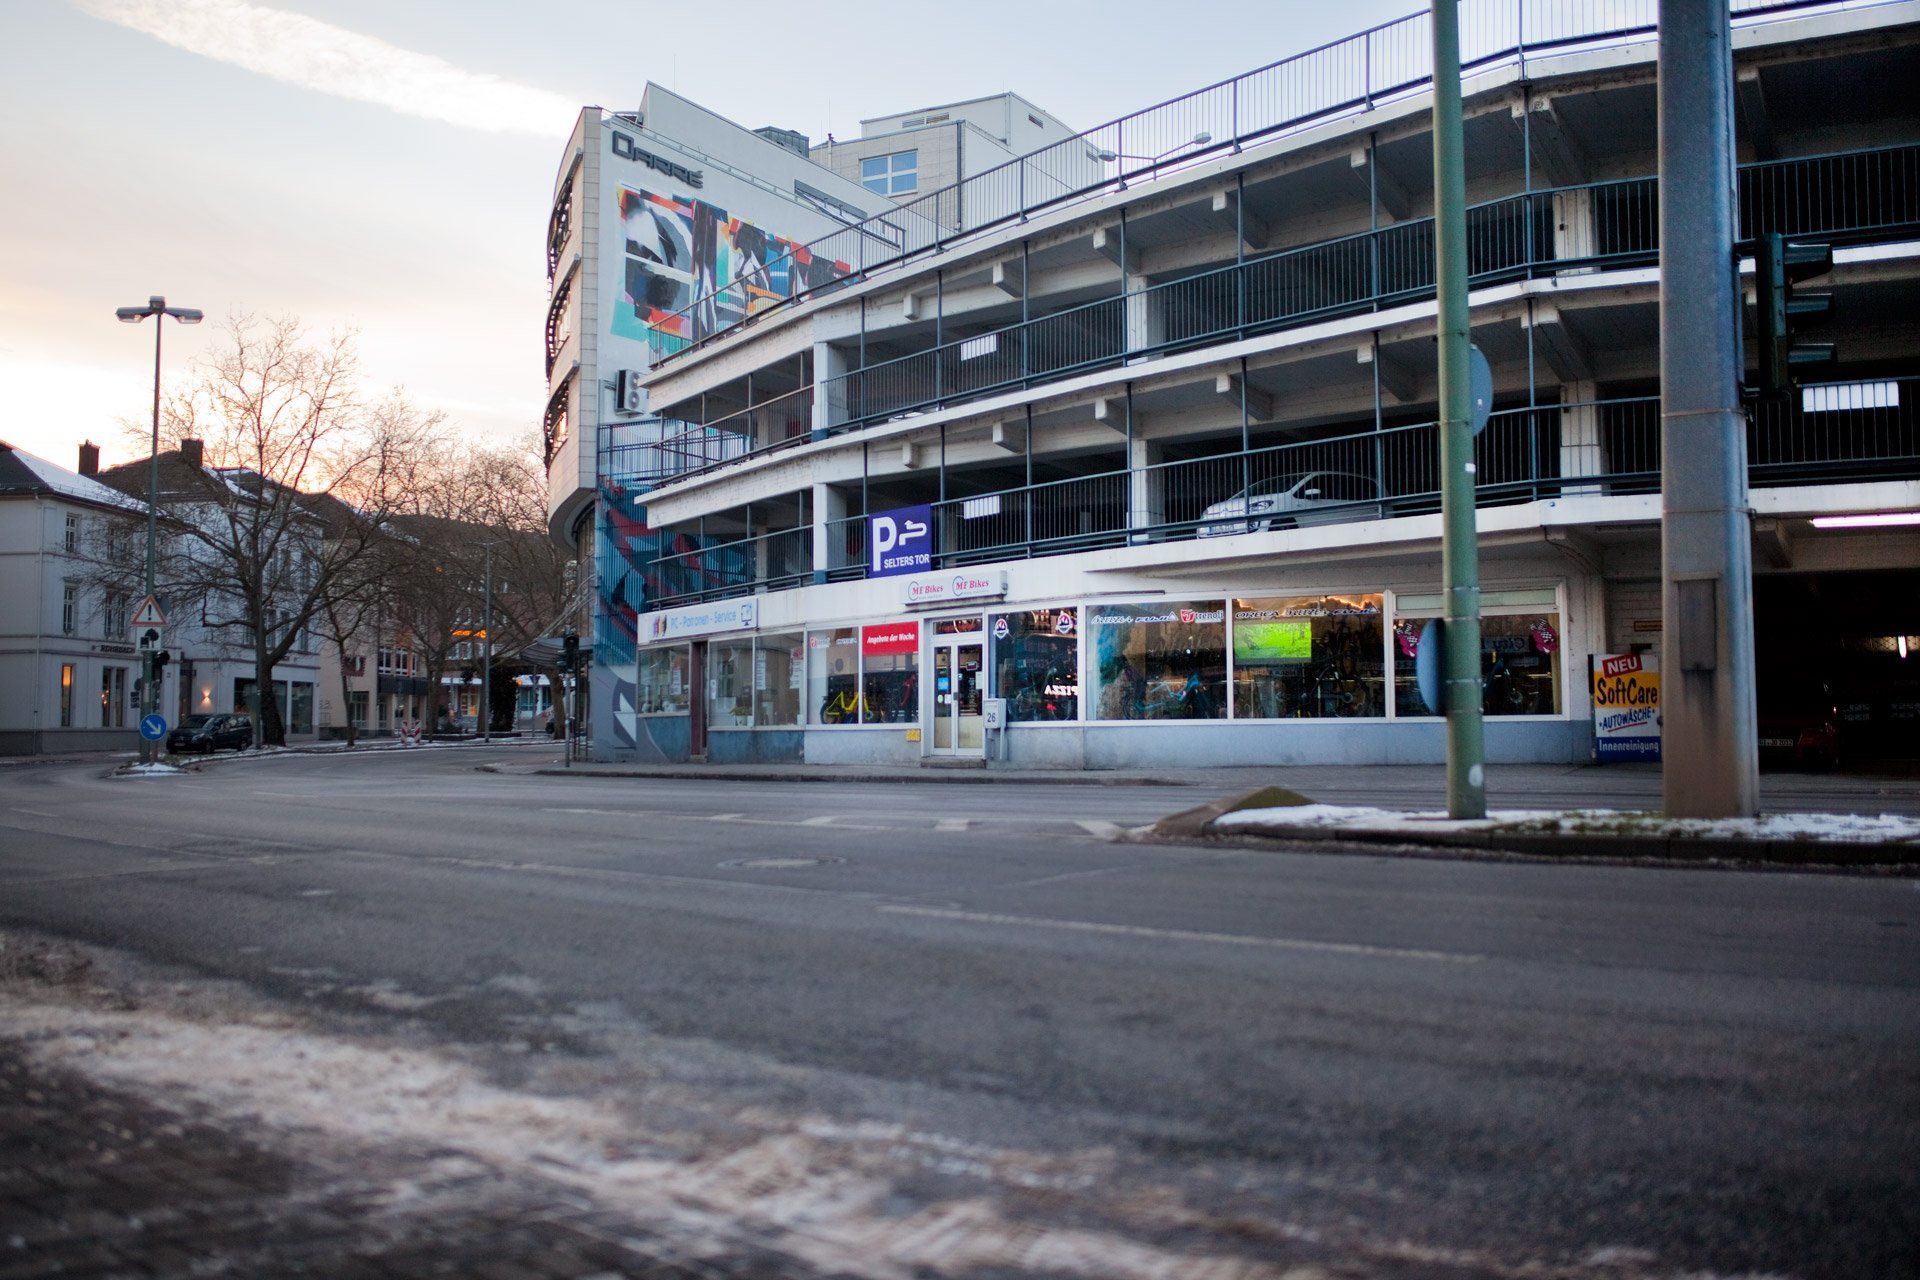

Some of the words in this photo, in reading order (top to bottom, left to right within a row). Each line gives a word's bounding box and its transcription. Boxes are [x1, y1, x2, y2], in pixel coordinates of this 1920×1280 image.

[873, 516, 897, 571] P
[884, 556, 914, 569] SELTERS
[914, 554, 930, 565] TOR
[924, 585, 944, 594] Bikes
[969, 580, 989, 589] Bikes
[670, 616, 678, 630] PC
[714, 609, 736, 624] Service
[866, 635, 889, 645] Angebote
[890, 633, 898, 641] der
[898, 632, 915, 641] Woche
[1607, 656, 1637, 675] NEU
[1597, 677, 1658, 705] SoftCare
[988, 713, 997, 723] 26
[1598, 739, 1659, 753] Innenreinigung
